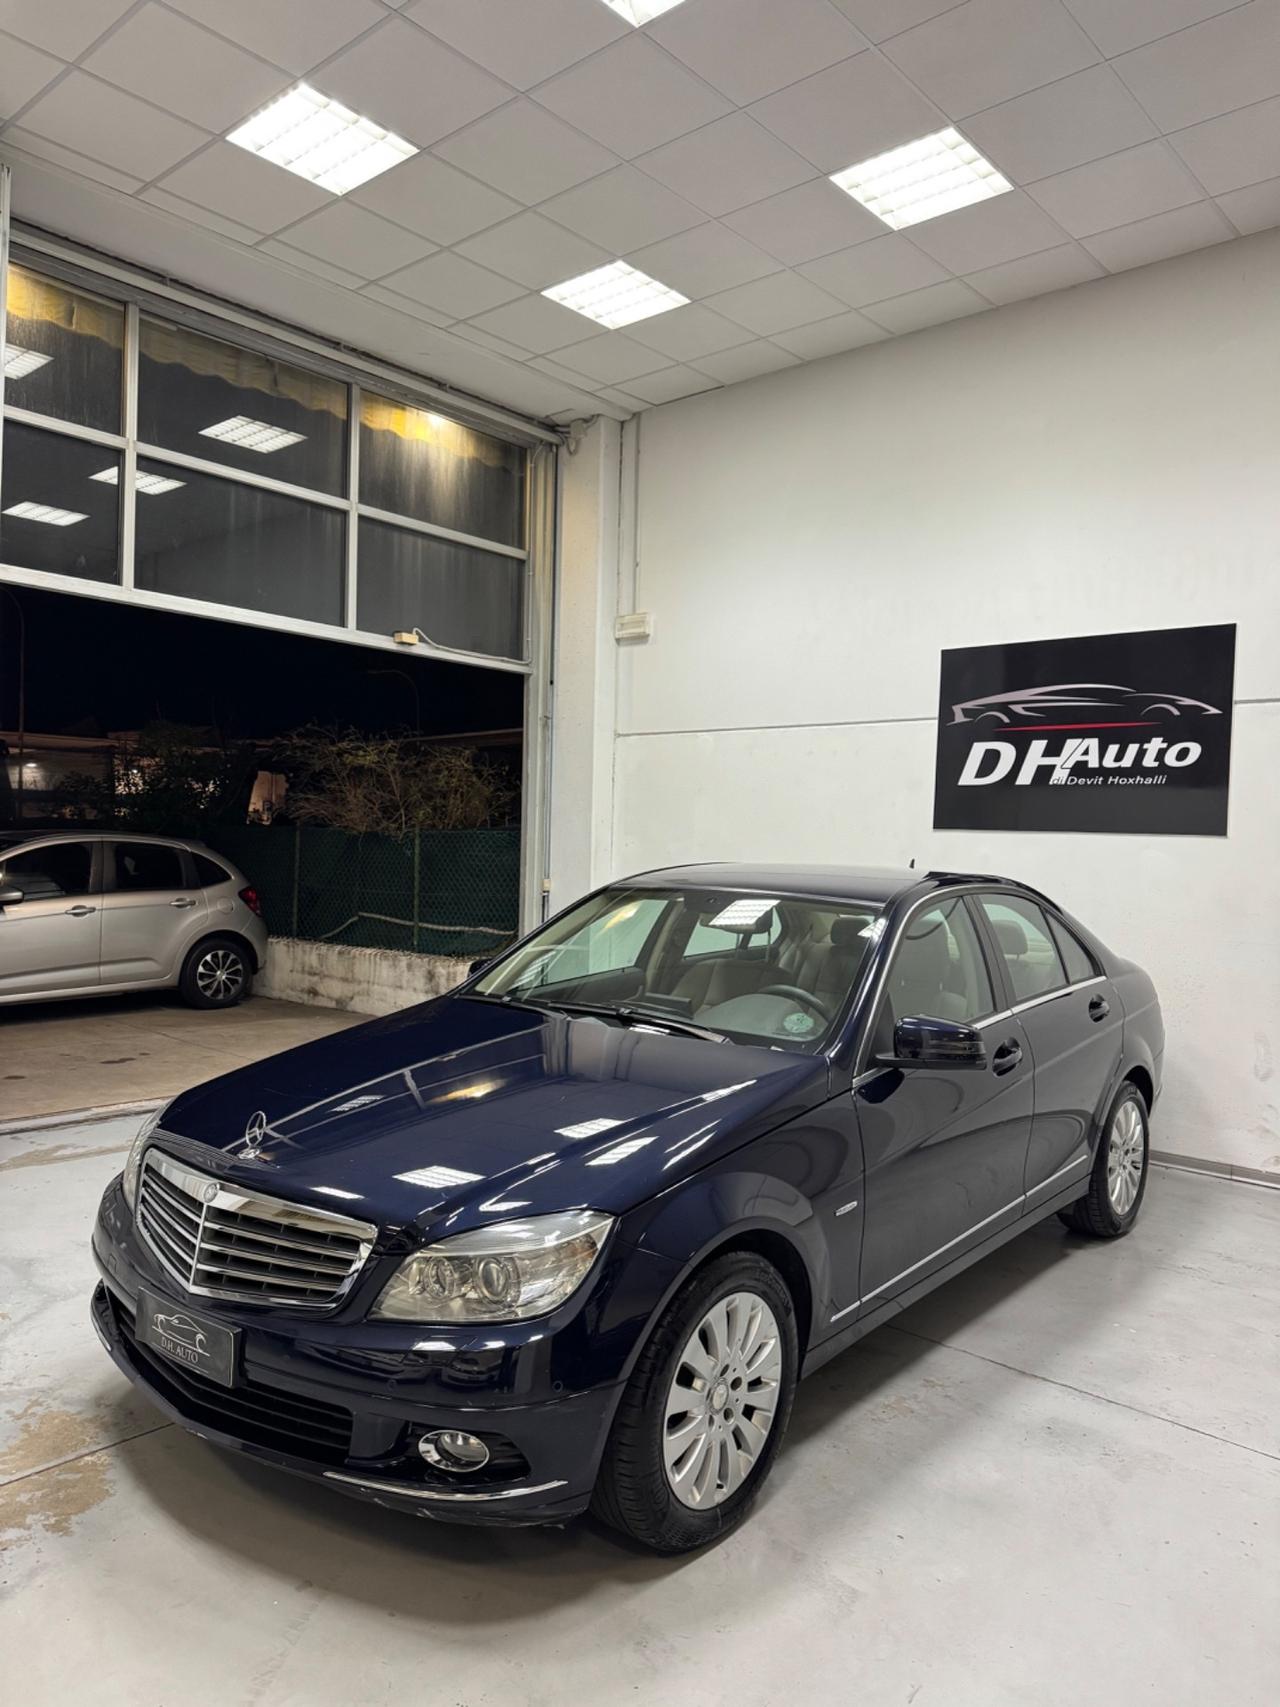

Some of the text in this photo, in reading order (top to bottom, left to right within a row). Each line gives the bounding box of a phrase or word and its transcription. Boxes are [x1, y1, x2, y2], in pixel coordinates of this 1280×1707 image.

[1067, 775, 1104, 785] Devit
[1107, 774, 1168, 785] Hoxhalli
[176, 1345, 198, 1363] AUTO
